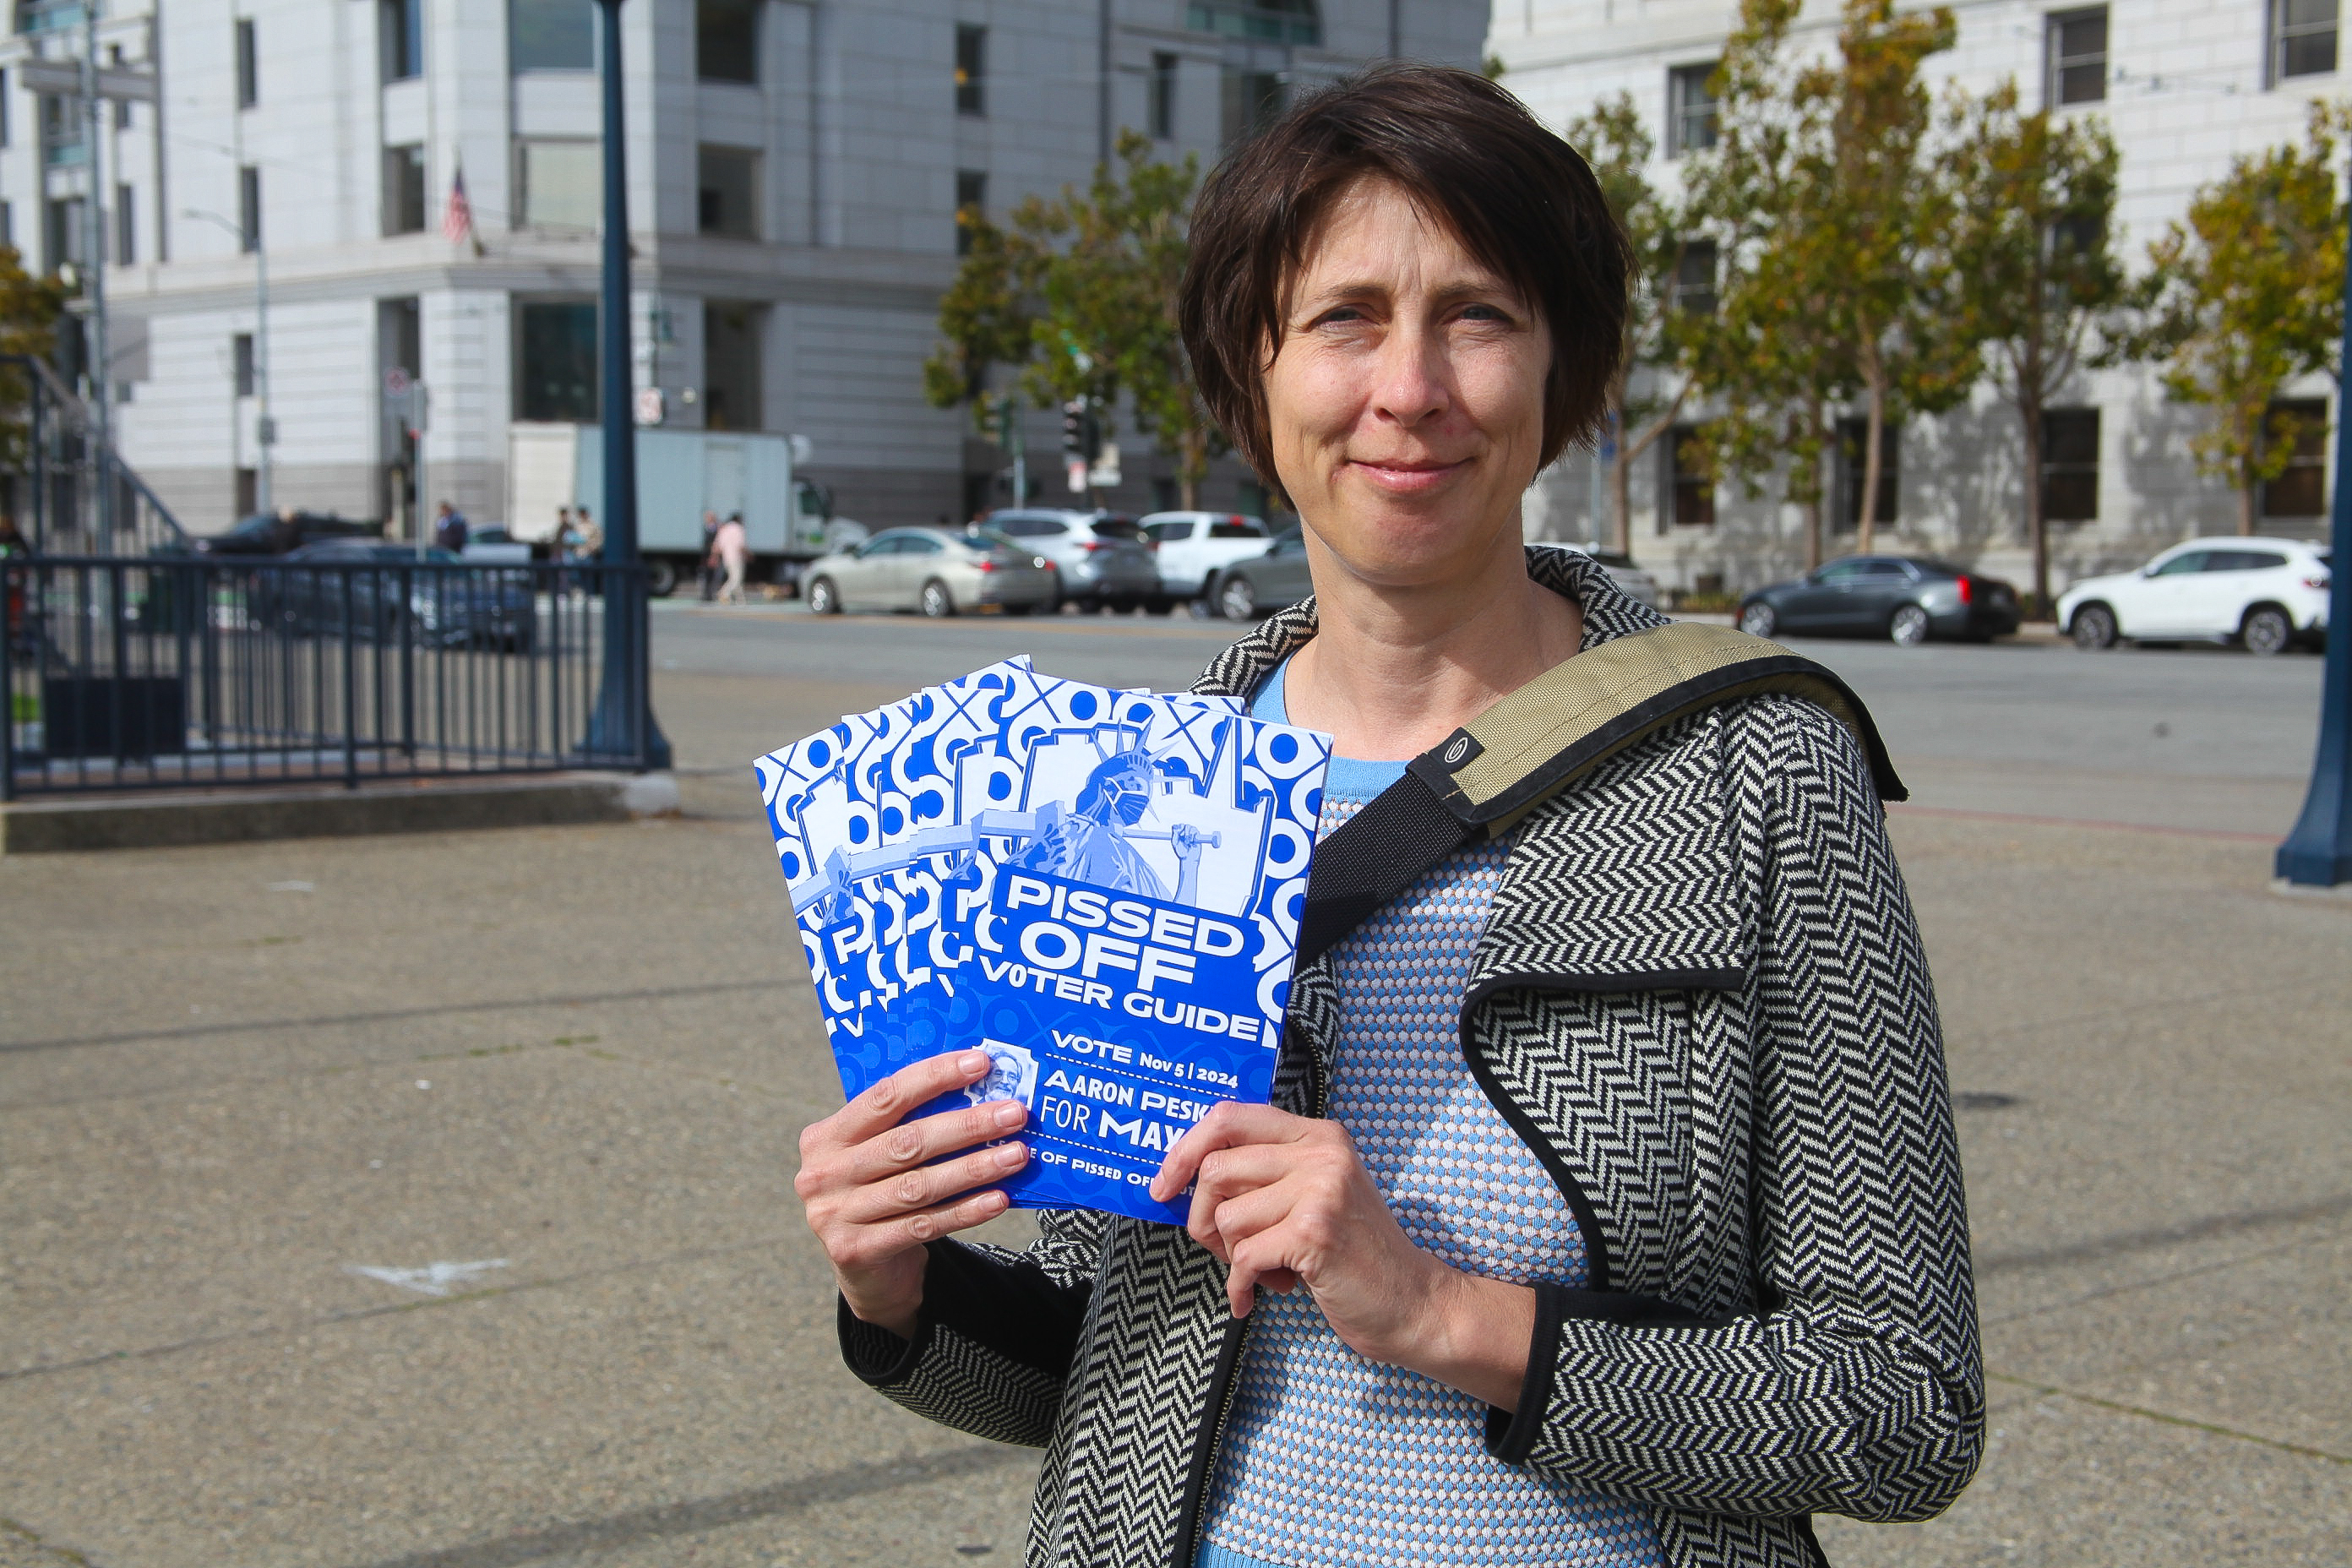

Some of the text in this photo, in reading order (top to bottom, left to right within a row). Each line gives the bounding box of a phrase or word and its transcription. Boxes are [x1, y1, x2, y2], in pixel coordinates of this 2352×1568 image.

[1006, 874, 1244, 957] PISSED
[1020, 920, 1197, 992] OFF
[978, 955, 1113, 1010] VOTER
[1122, 992, 1260, 1042] GUIDE
[1051, 1029, 1133, 1064] VOTE
[1139, 1052, 1174, 1072] Nov
[1173, 1064, 1184, 1078] 5
[1195, 1067, 1239, 1089] 2024
[1040, 1095, 1185, 1153] FOR MAY
[1043, 1070, 1212, 1123] AARON PESK
[1041, 1150, 1155, 1187] OF PISSED OF
